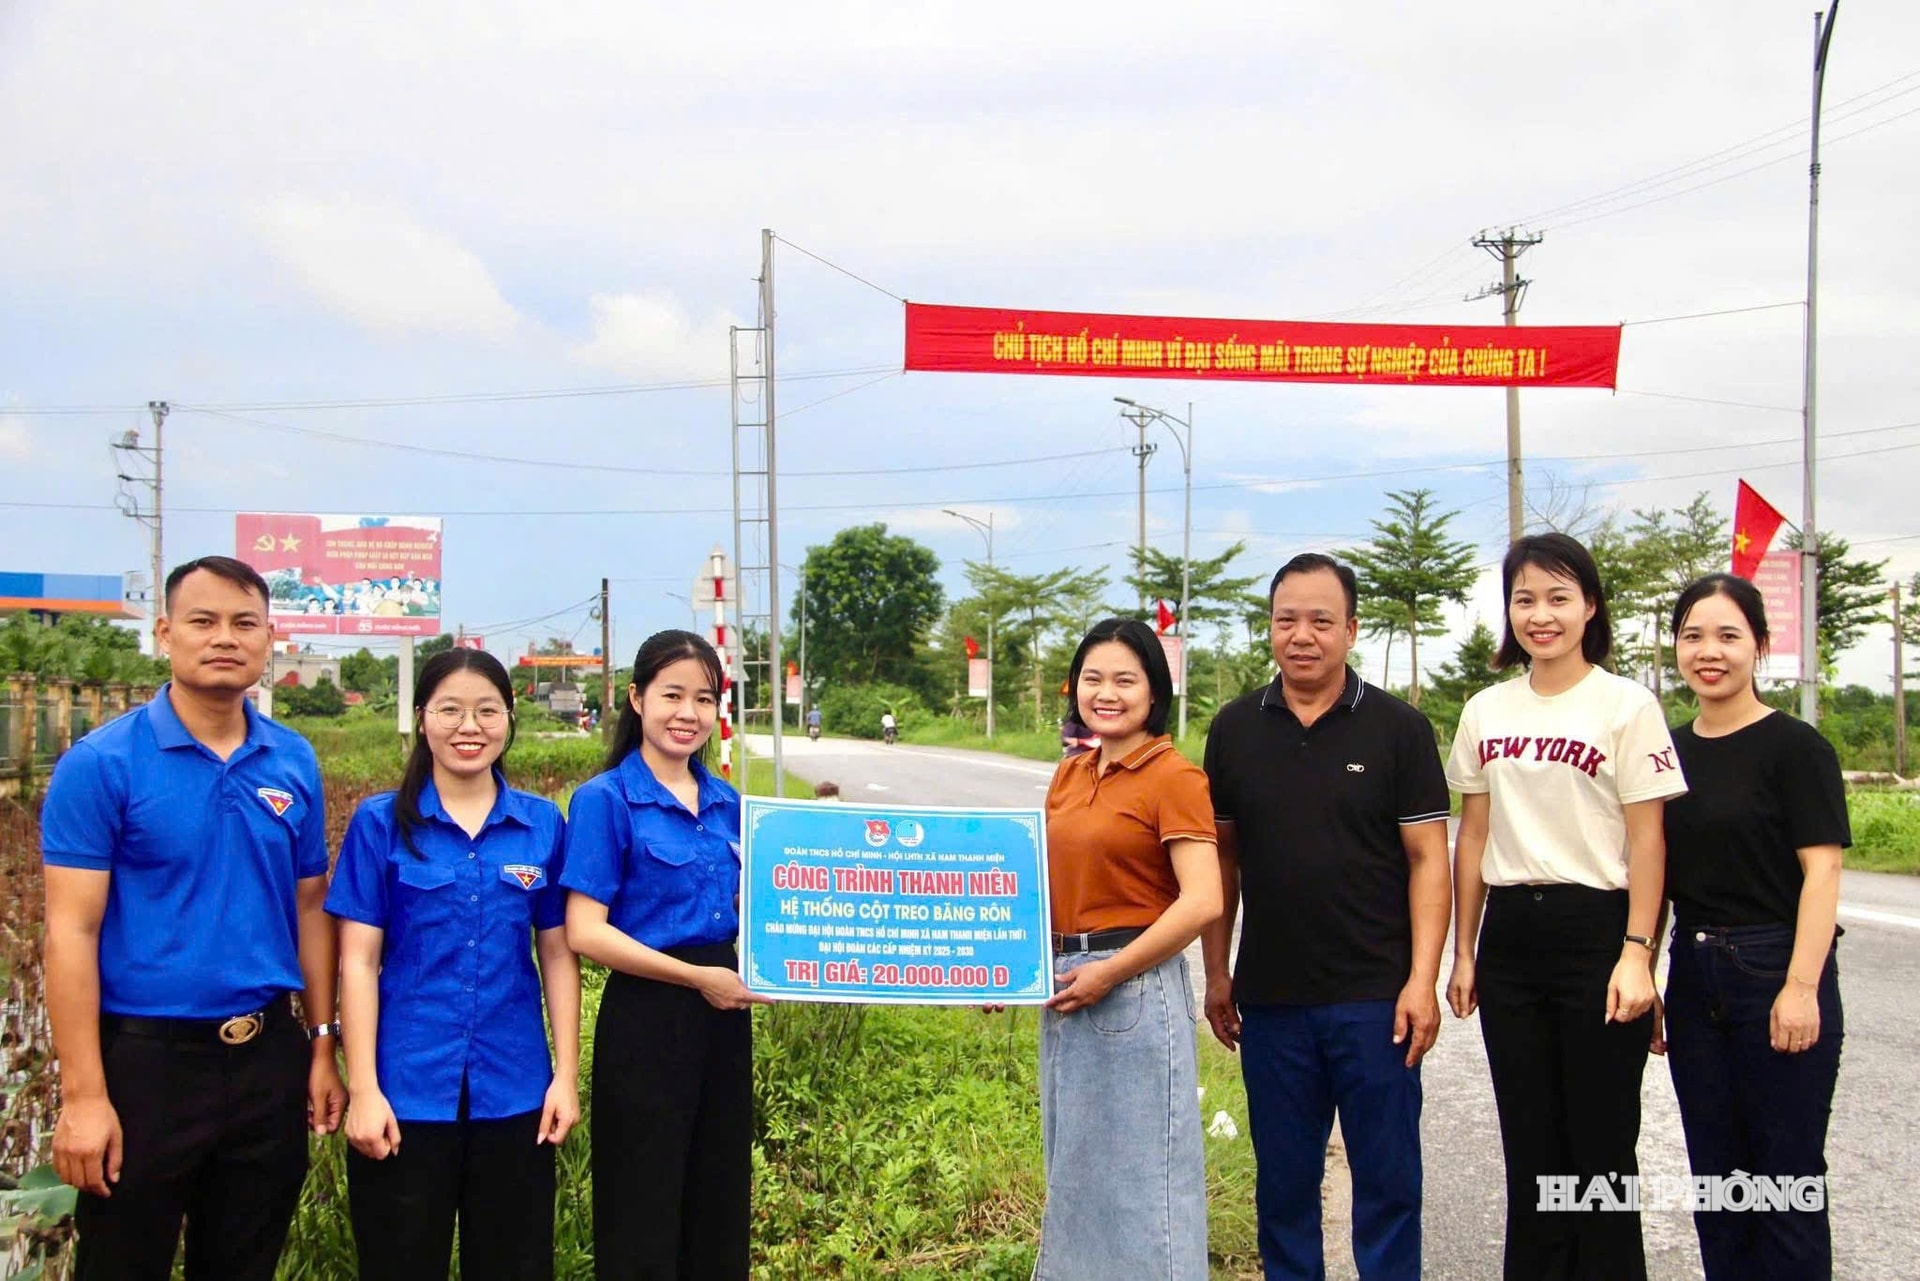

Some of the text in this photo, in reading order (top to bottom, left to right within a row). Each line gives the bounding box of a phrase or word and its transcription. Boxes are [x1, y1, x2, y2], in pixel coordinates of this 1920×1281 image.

[993, 321, 1025, 361] CHỦ
[1028, 334, 1063, 368] TỊCH
[1092, 332, 1118, 366] CHÍ
[1121, 339, 1162, 368] MINH
[1166, 336, 1183, 368] VĨ
[1184, 342, 1211, 374] ĐẠI
[1214, 333, 1256, 371] SỐNG
[1260, 340, 1290, 372] MÃI
[1294, 346, 1342, 373] TRONG
[1346, 344, 1371, 380] SỰ
[1371, 341, 1426, 381] NGHIỆP
[1429, 336, 1458, 376] CỦA
[1463, 342, 1514, 376] CHÚNG
[1517, 349, 1535, 376] TA
[1534, 737, 1607, 778] YORK
[861, 851, 882, 860] MINH
[938, 853, 956, 862] NAM
[958, 854, 984, 863] THANH
[773, 861, 1018, 896] CÔNG TRÌNH THANH NIÊN
[781, 896, 1011, 924] HỆ THỐNG CỘT TREO BĂNG RÔN
[950, 929, 973, 940] THANH
[784, 958, 1010, 988] TRỊ GIÁ: 20.000.000 Đ
